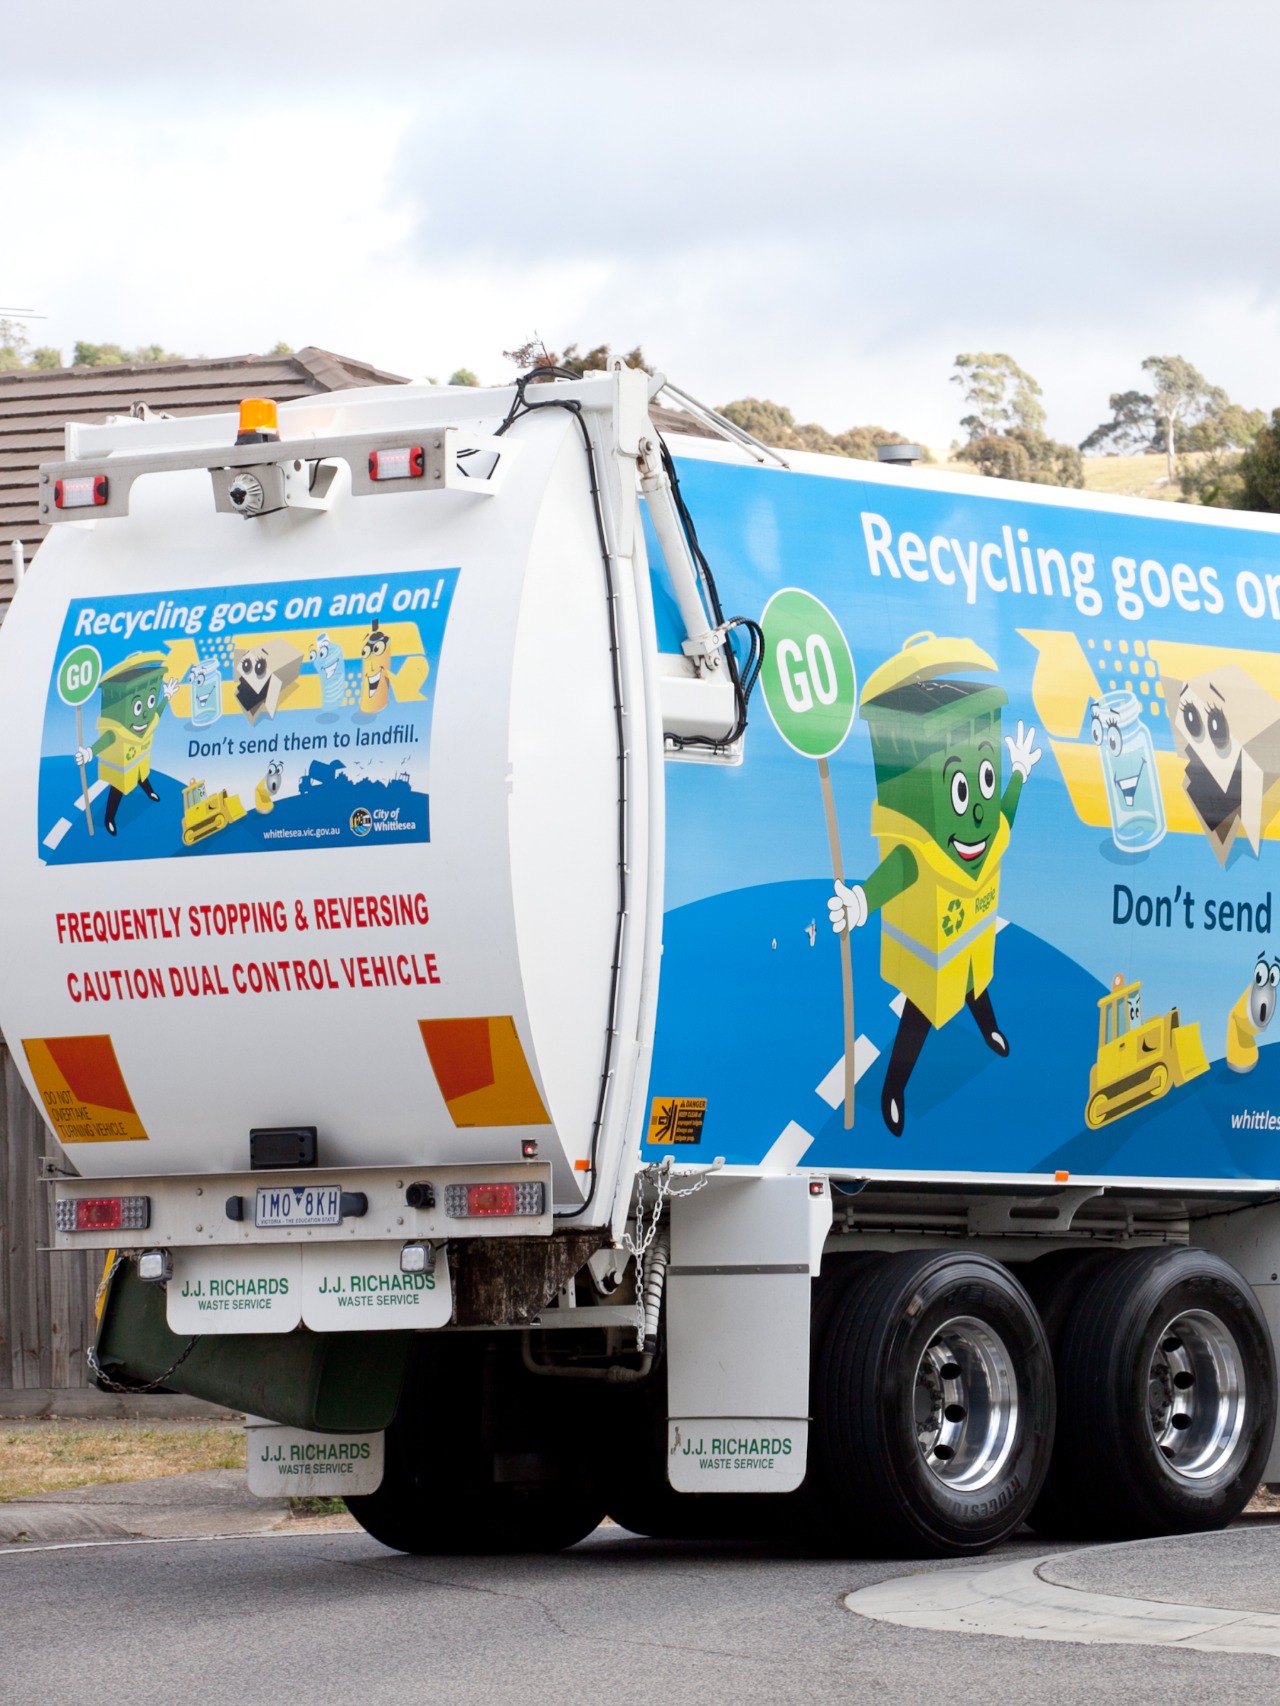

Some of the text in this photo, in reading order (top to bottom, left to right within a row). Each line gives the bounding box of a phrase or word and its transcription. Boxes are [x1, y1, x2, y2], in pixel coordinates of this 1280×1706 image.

[861, 512, 1103, 616] Recycling
[1112, 557, 1224, 620] goes
[75, 580, 442, 640] Recycling goes on and on!
[67, 660, 92, 691] GO
[776, 634, 838, 714] GO
[189, 724, 420, 758] Don't send them to landfill.
[373, 808, 400, 821] City of
[263, 827, 341, 839] whittlesea.vic.gov.au
[373, 820, 416, 832] Whittlesea
[1113, 884, 1194, 928] Don't
[1204, 892, 1271, 933] send
[56, 894, 428, 943] FREQUENTLY STOPPING & REVERSING
[68, 954, 440, 1002] CAUTION DUAL CONTROL VEHICLE
[44, 1090, 74, 1105] DO NOT
[686, 1100, 706, 1108] DANGER
[51, 1107, 92, 1121] OVERTAKE
[58, 1122, 128, 1138] TURNING VEHICLE
[181, 1277, 289, 1298] J.J. RICHARDS
[319, 1274, 435, 1295] J.J. RICHARDS
[198, 1298, 272, 1311] WASTE SERVICE
[338, 1294, 419, 1307] WASTE SERVICE
[261, 1443, 370, 1462] J.J. RICHARDS
[683, 1438, 792, 1455] J.J. RICHARDS
[278, 1463, 353, 1475] WASTE SERVICE
[699, 1458, 774, 1469] WASTE SERVICE
